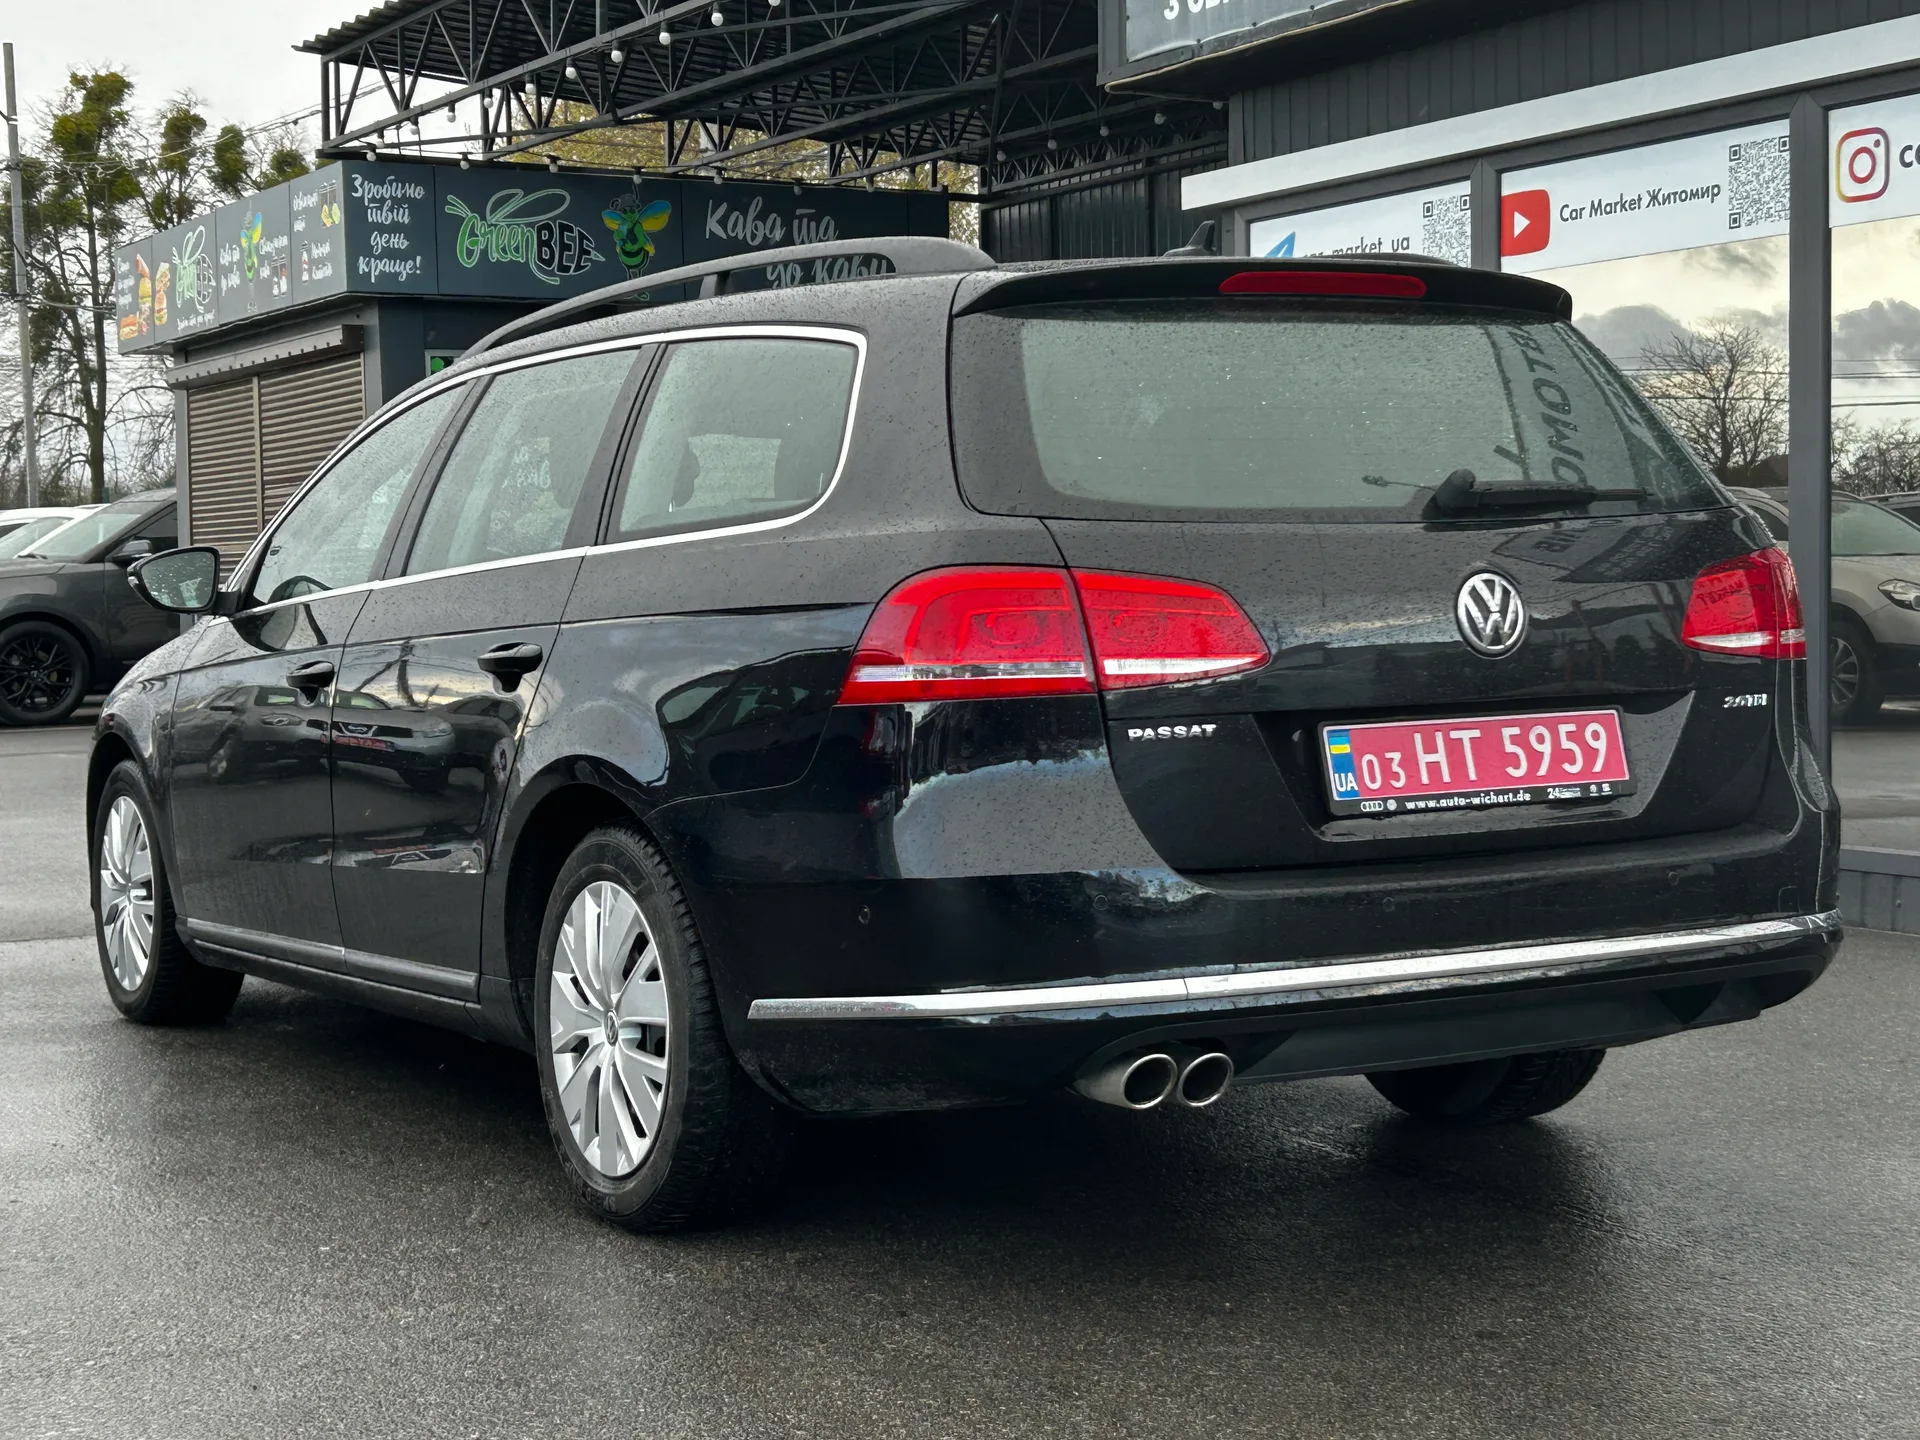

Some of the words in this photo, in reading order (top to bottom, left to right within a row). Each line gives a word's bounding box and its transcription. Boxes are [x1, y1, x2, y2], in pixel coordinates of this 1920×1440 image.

[351, 174, 425, 206] Зробимо
[1559, 204, 1586, 222] Car
[1589, 193, 1643, 217] Market
[1645, 183, 1721, 209] Житомир
[367, 200, 411, 225] твій
[705, 196, 786, 246] Кава
[370, 231, 409, 255] день
[357, 255, 422, 283] краще!
[1127, 724, 1217, 741] PASSAT
[1361, 752, 1406, 790] 03
[1413, 730, 1480, 785] HT
[1501, 723, 1607, 778] 5959
[1334, 773, 1359, 792] UA
